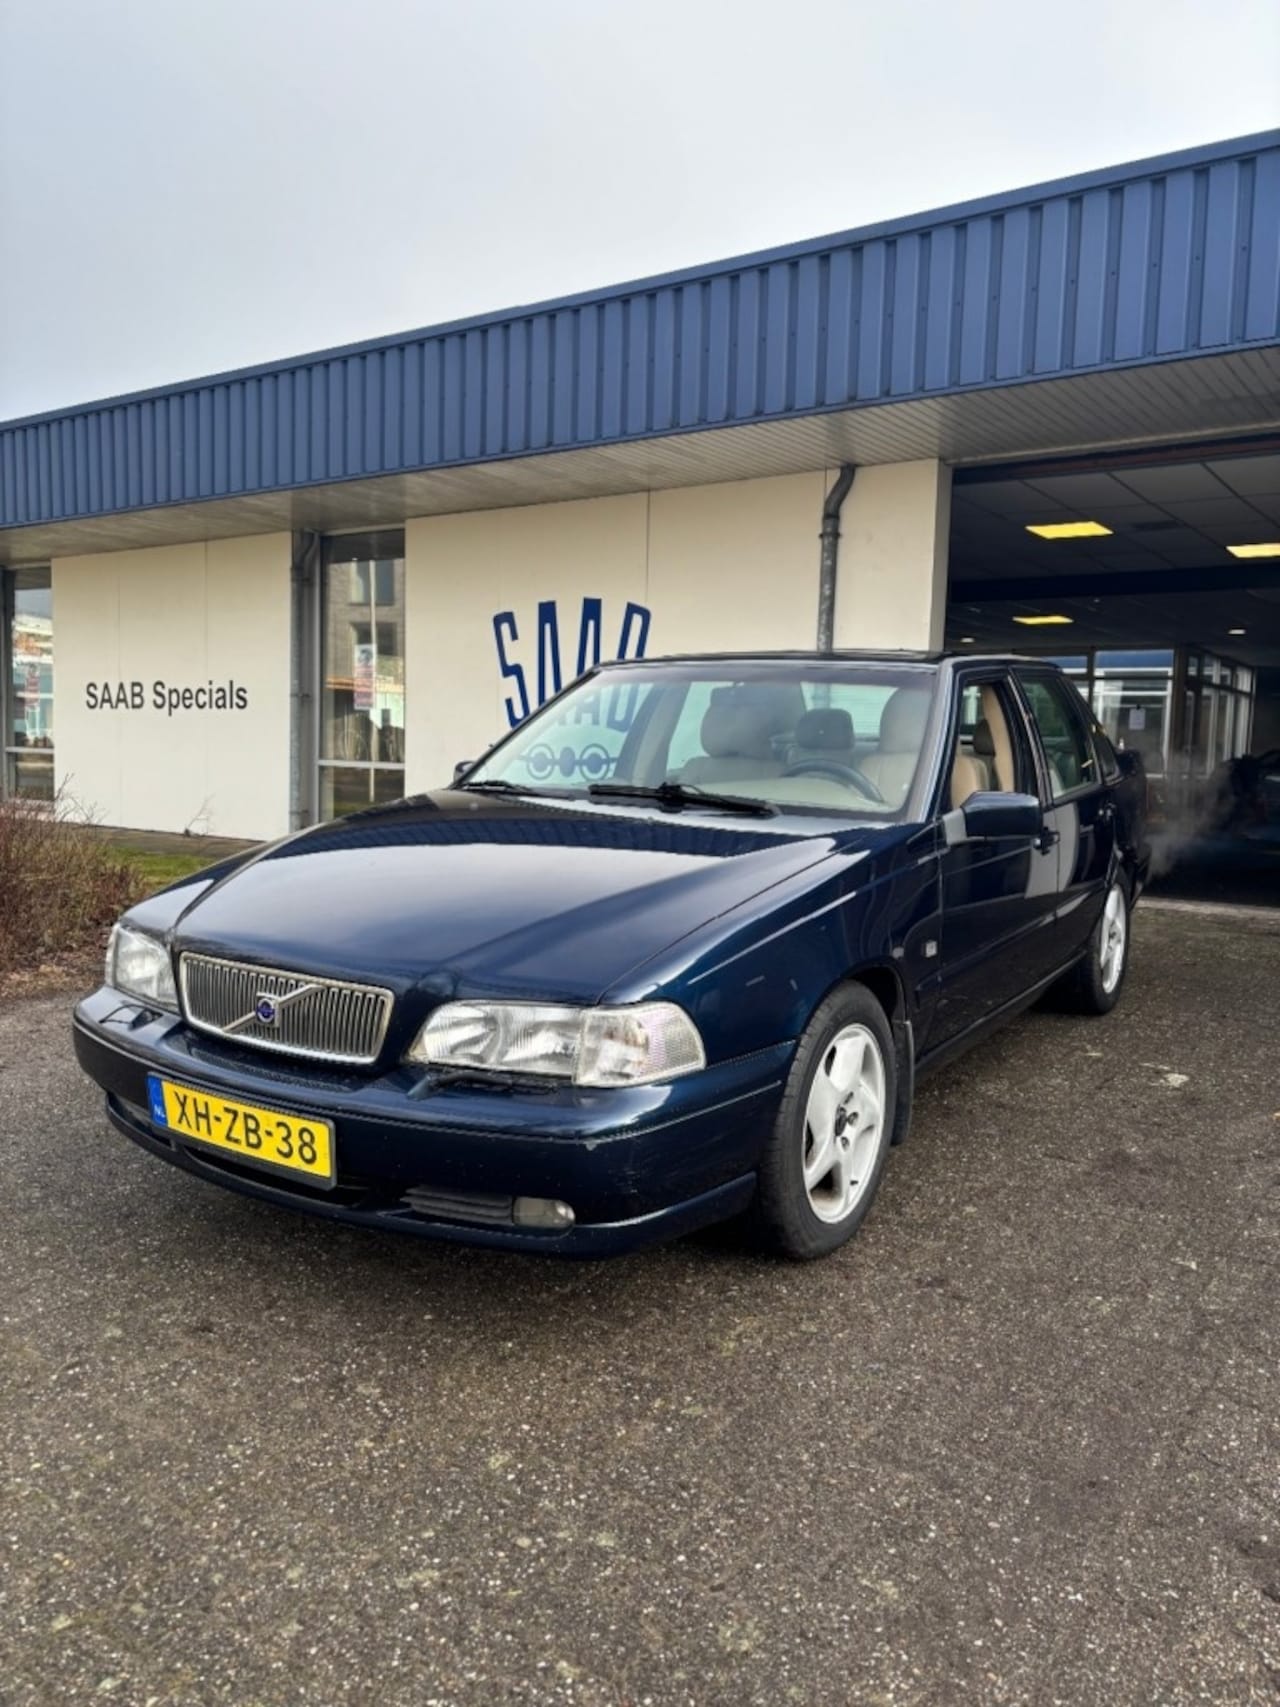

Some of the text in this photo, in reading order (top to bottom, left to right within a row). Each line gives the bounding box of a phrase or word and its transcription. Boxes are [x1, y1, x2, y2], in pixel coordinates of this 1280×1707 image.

[86, 680, 248, 717] SAAB Specials
[173, 1090, 318, 1165] XH-ZB-38
